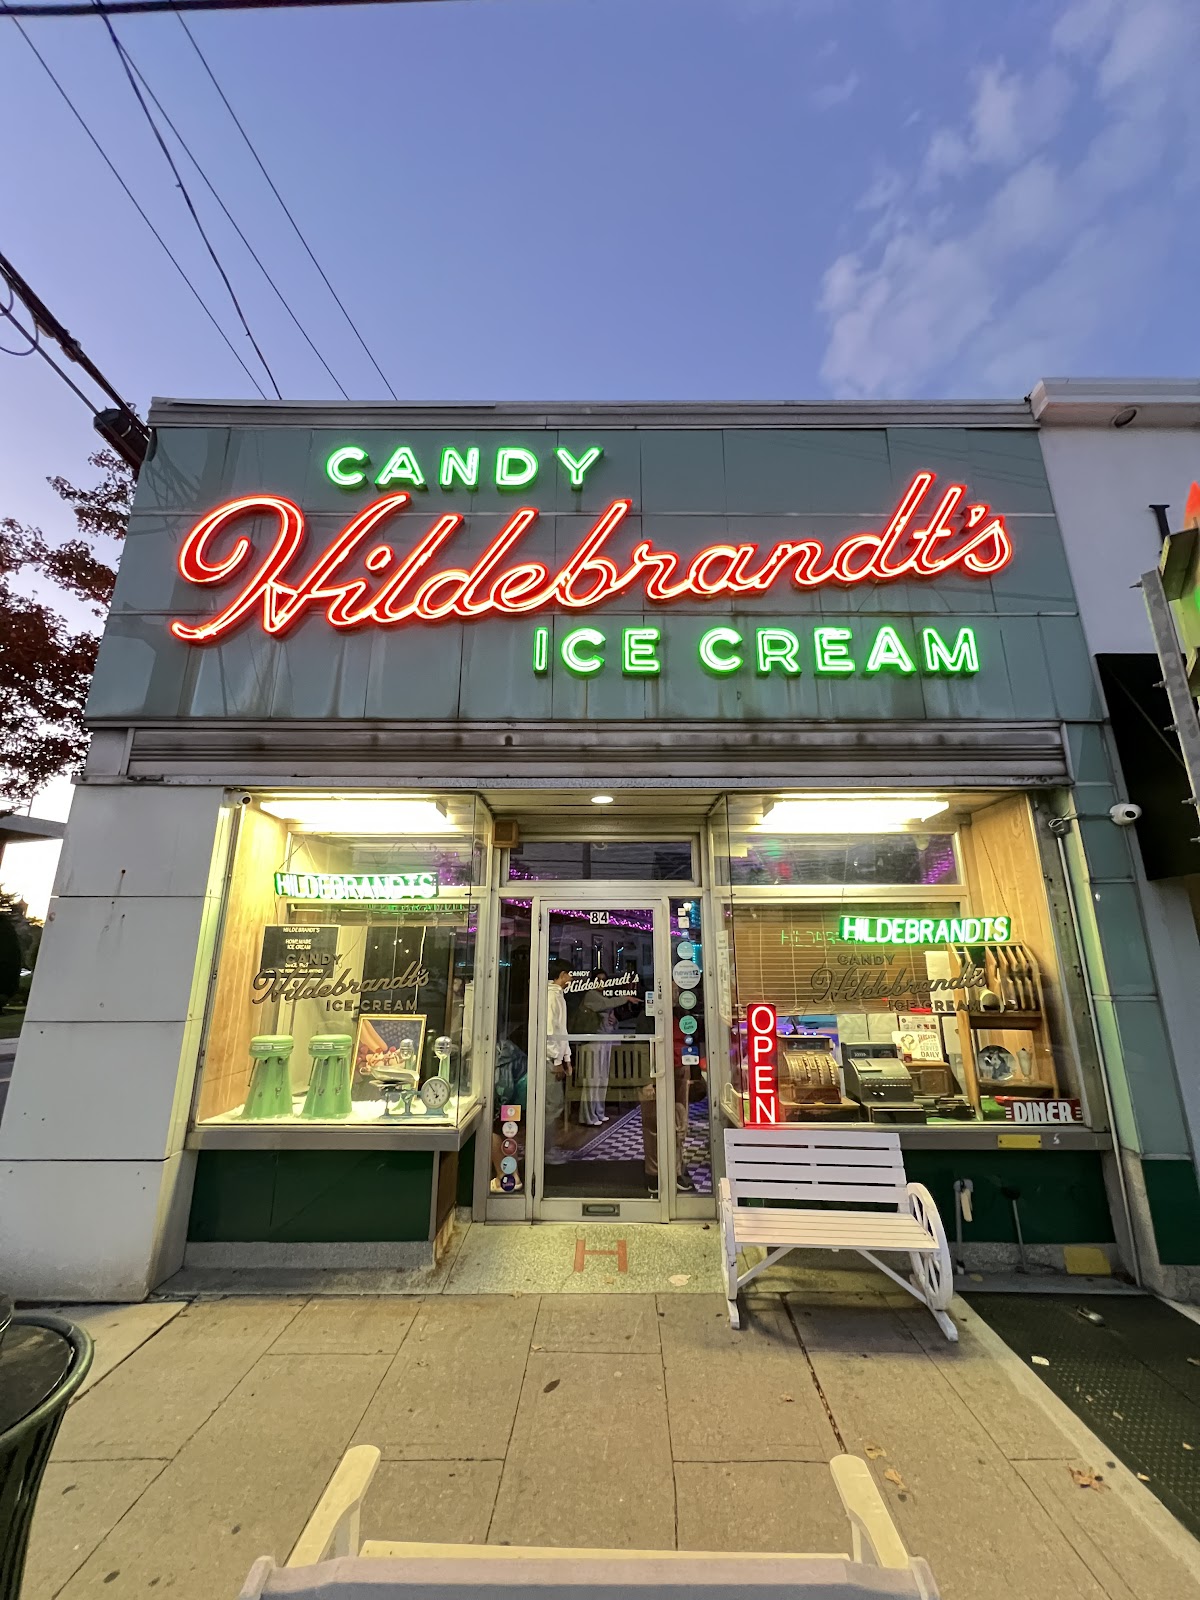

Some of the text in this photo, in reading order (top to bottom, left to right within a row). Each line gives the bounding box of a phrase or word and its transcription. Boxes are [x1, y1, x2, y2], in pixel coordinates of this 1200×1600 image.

[326, 446, 603, 488] CANDY
[170, 471, 1013, 641] Hildebrandt's
[533, 625, 981, 675] ICE CREAM
[591, 912, 608, 923] 84
[285, 953, 343, 966] CANDY
[837, 953, 896, 966] CANDY
[252, 960, 430, 1005] Hildebrandt's
[563, 970, 640, 994] Hildebrandt's
[326, 1000, 418, 1012] ICE CREAM
[888, 1000, 983, 1012] ICE CREAM
[751, 1006, 776, 1124] OPEN
[1013, 1102, 1075, 1122] DINER
[574, 1239, 628, 1274] H
